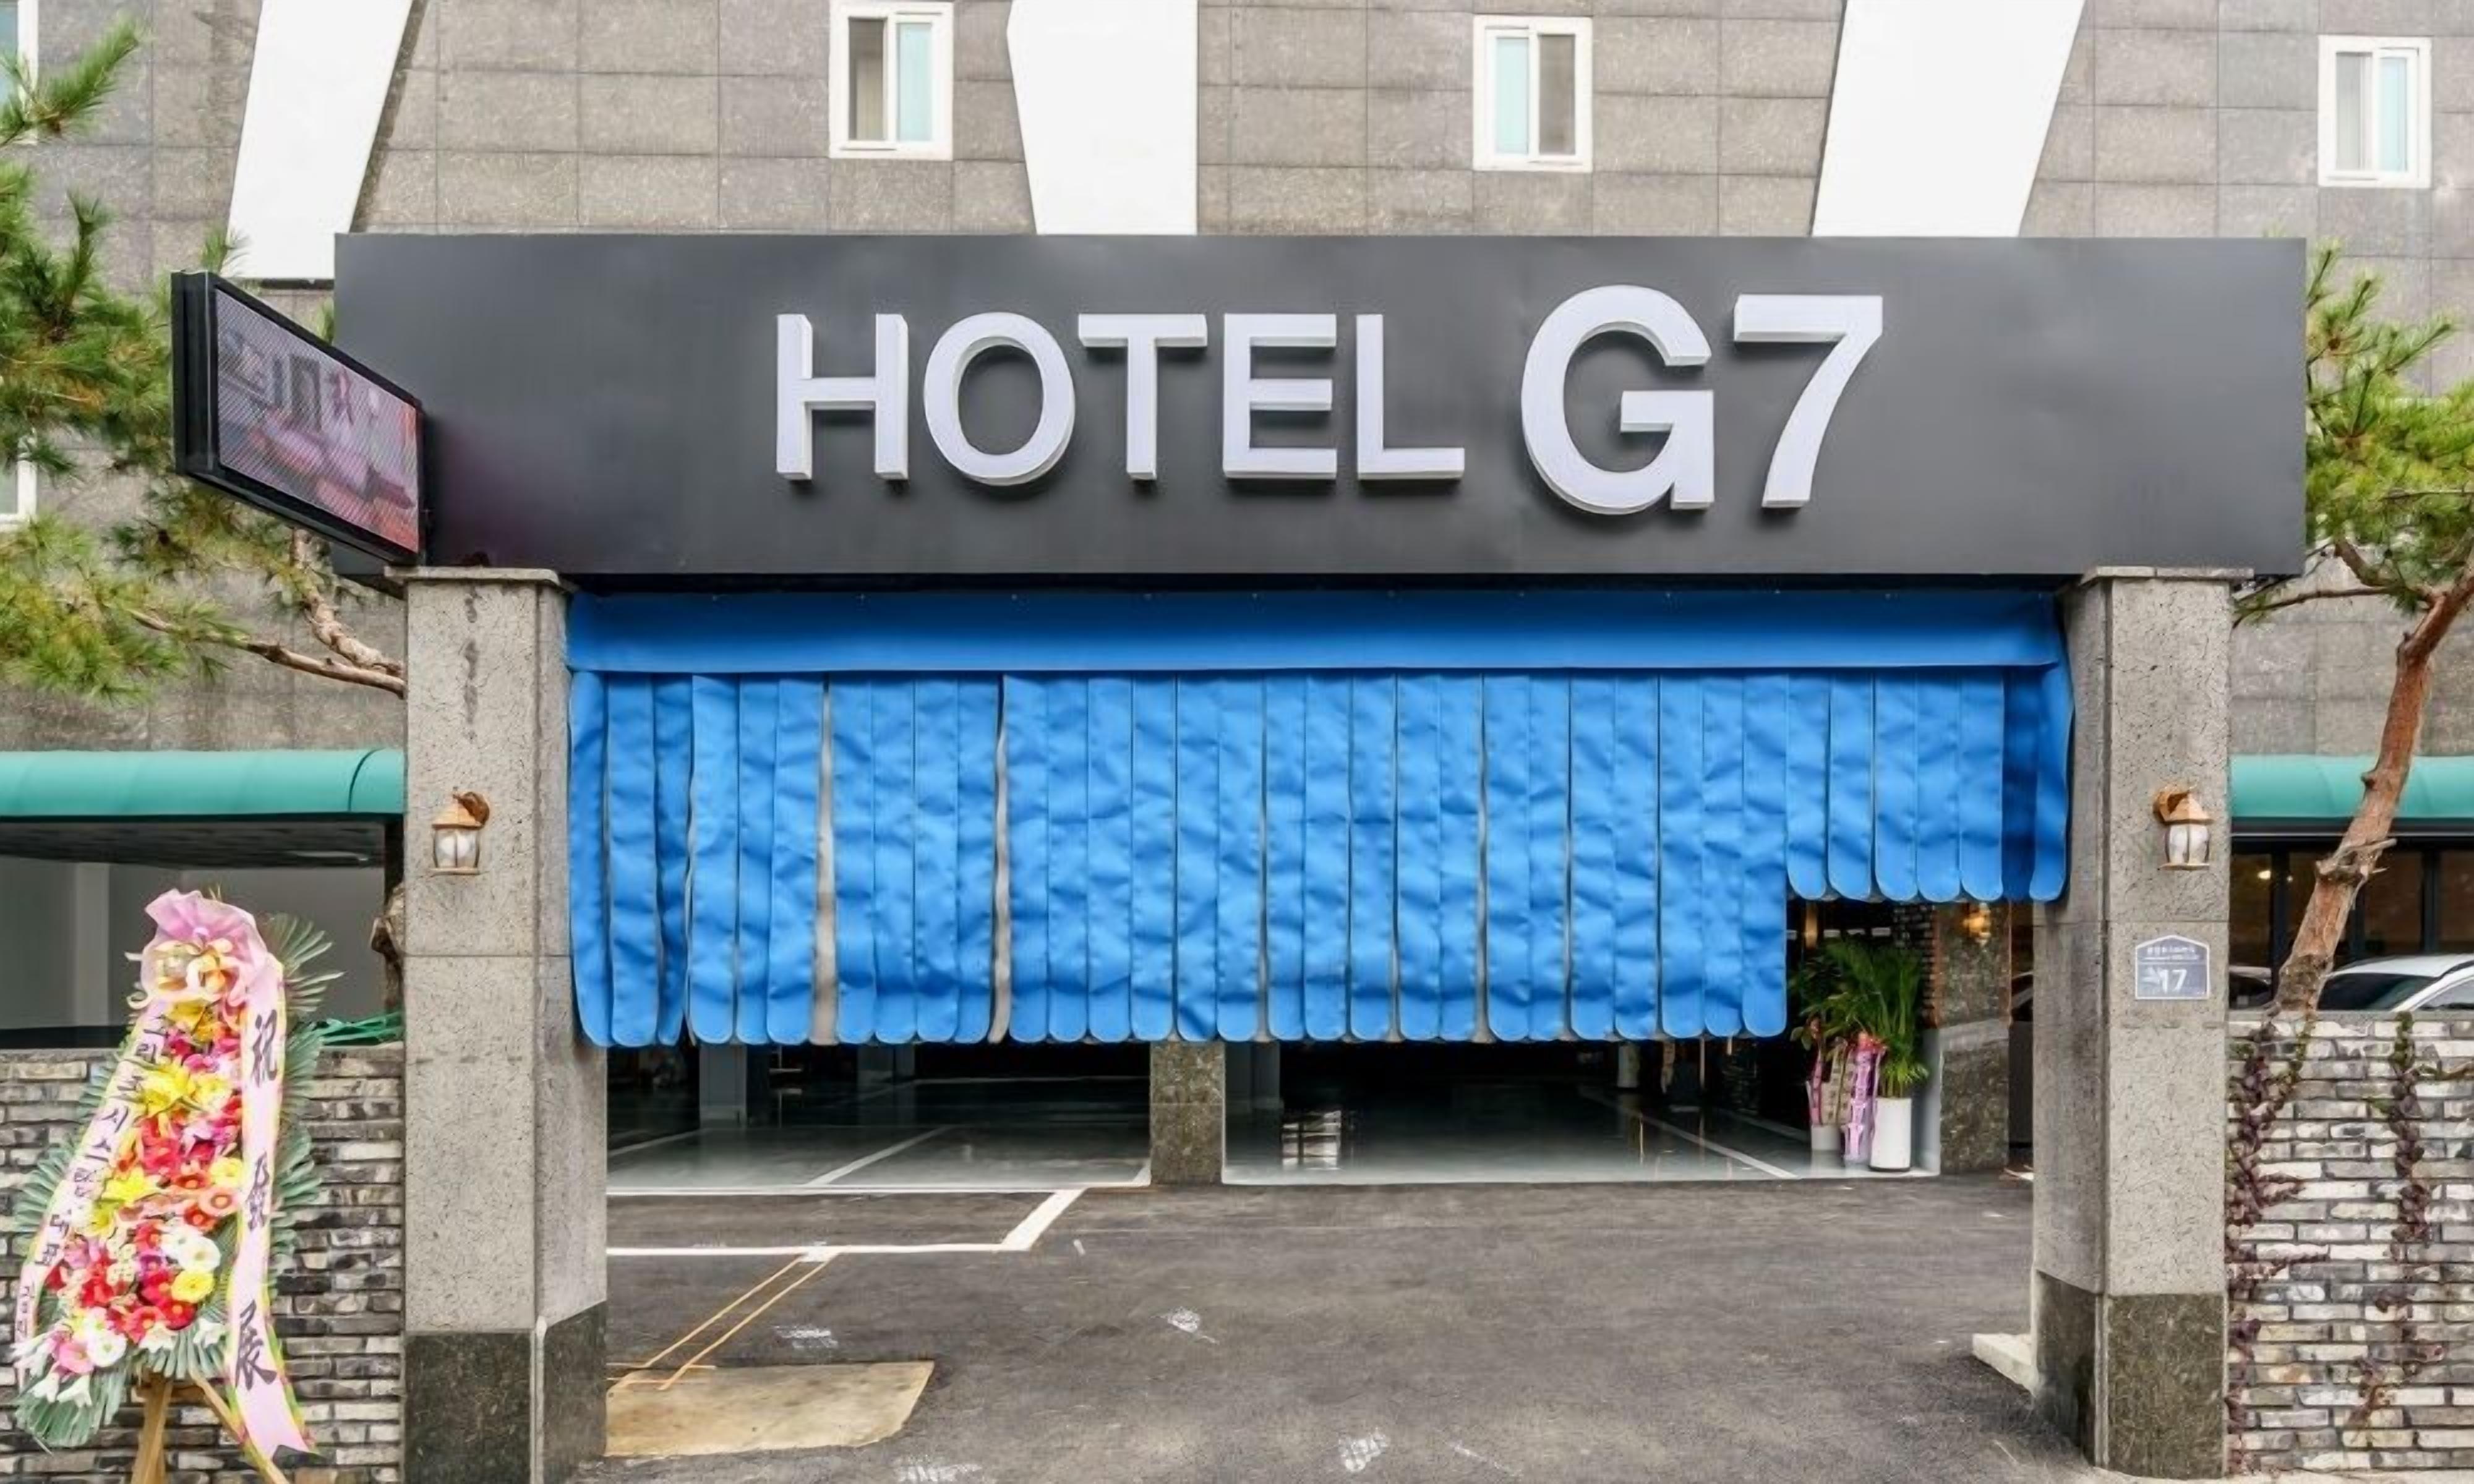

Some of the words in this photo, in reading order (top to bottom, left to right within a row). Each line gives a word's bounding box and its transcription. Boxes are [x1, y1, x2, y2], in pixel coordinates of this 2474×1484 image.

[776, 312, 1465, 486] HOTEL
[1521, 284, 1883, 516] G7
[2158, 968, 2188, 994] 17
